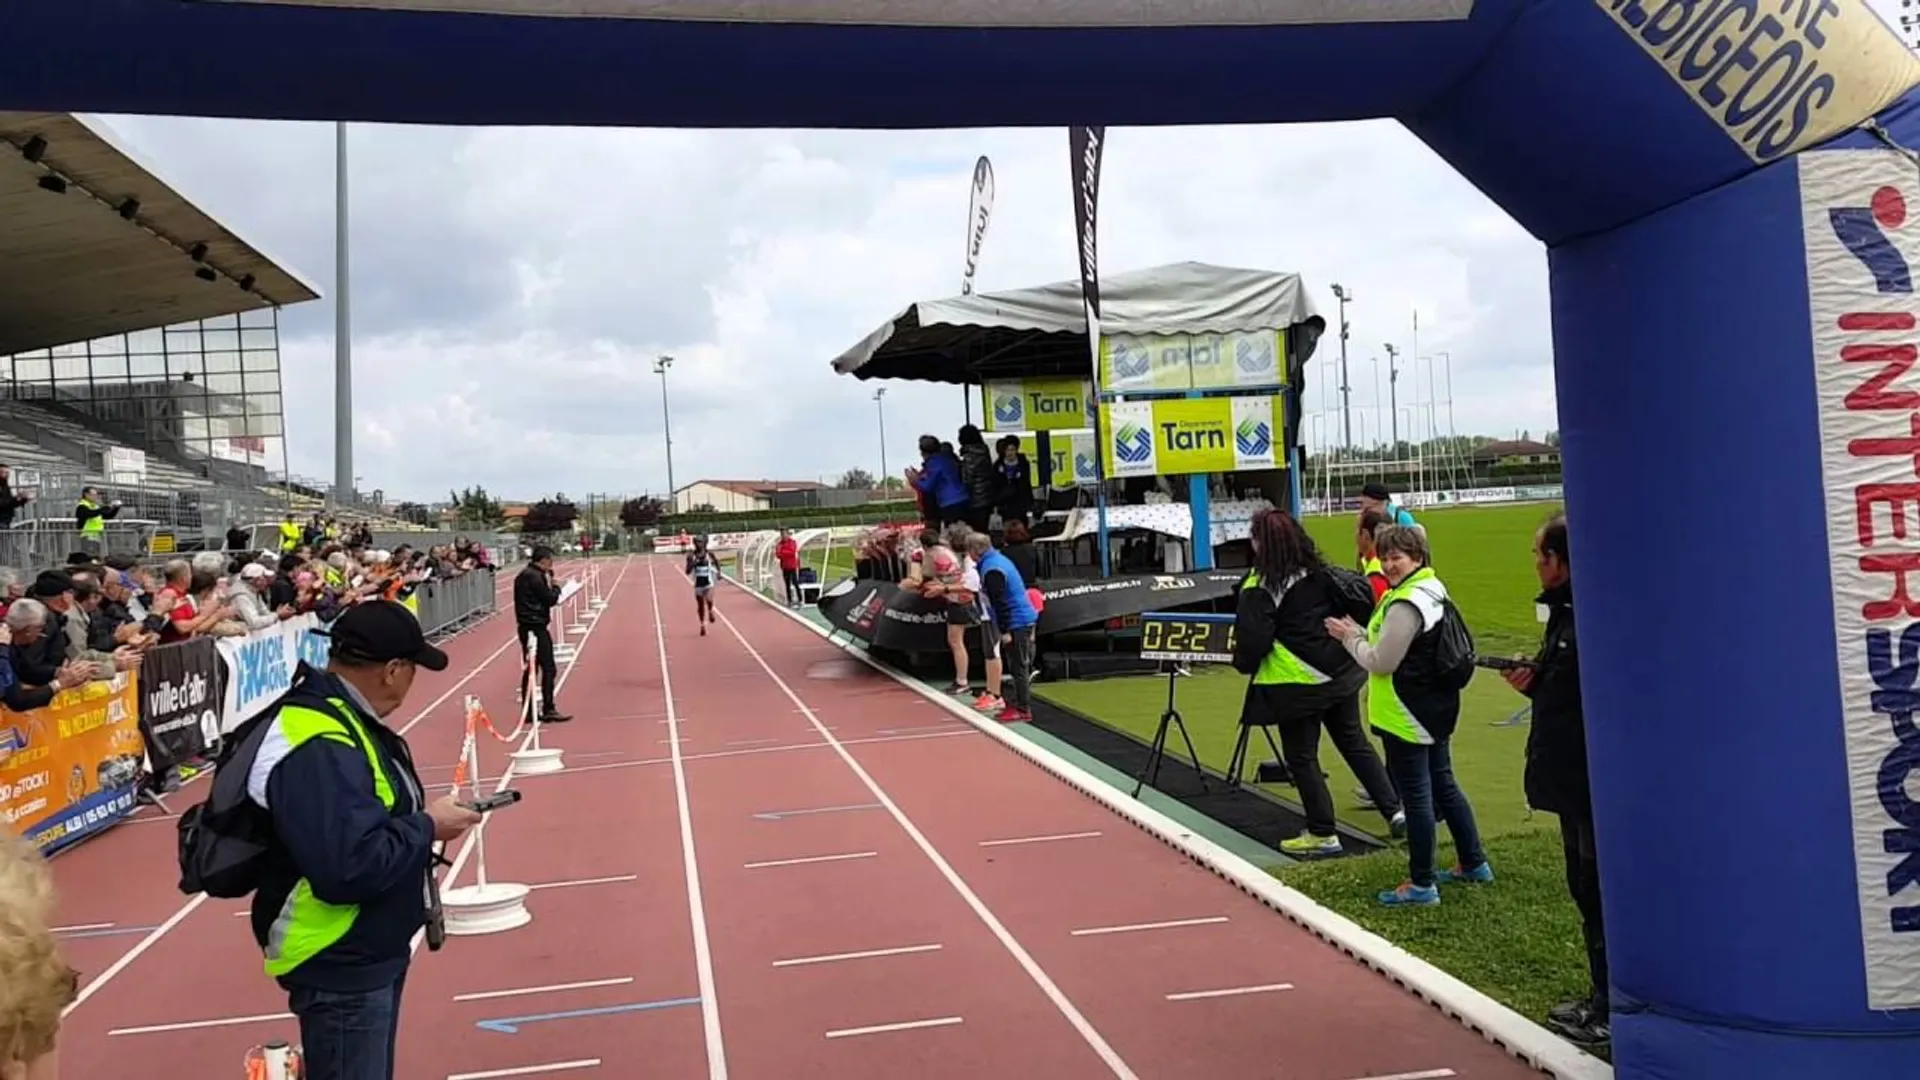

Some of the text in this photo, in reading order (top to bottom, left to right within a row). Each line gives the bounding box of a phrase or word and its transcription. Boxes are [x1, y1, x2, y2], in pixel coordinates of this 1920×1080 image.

[1611, 0, 1835, 158] BIGEOIS
[1084, 220, 1096, 284] ville
[1029, 392, 1077, 414] Tarn
[1161, 423, 1225, 450] Tarn
[150, 681, 179, 717] ville
[180, 671, 207, 709] d'albi
